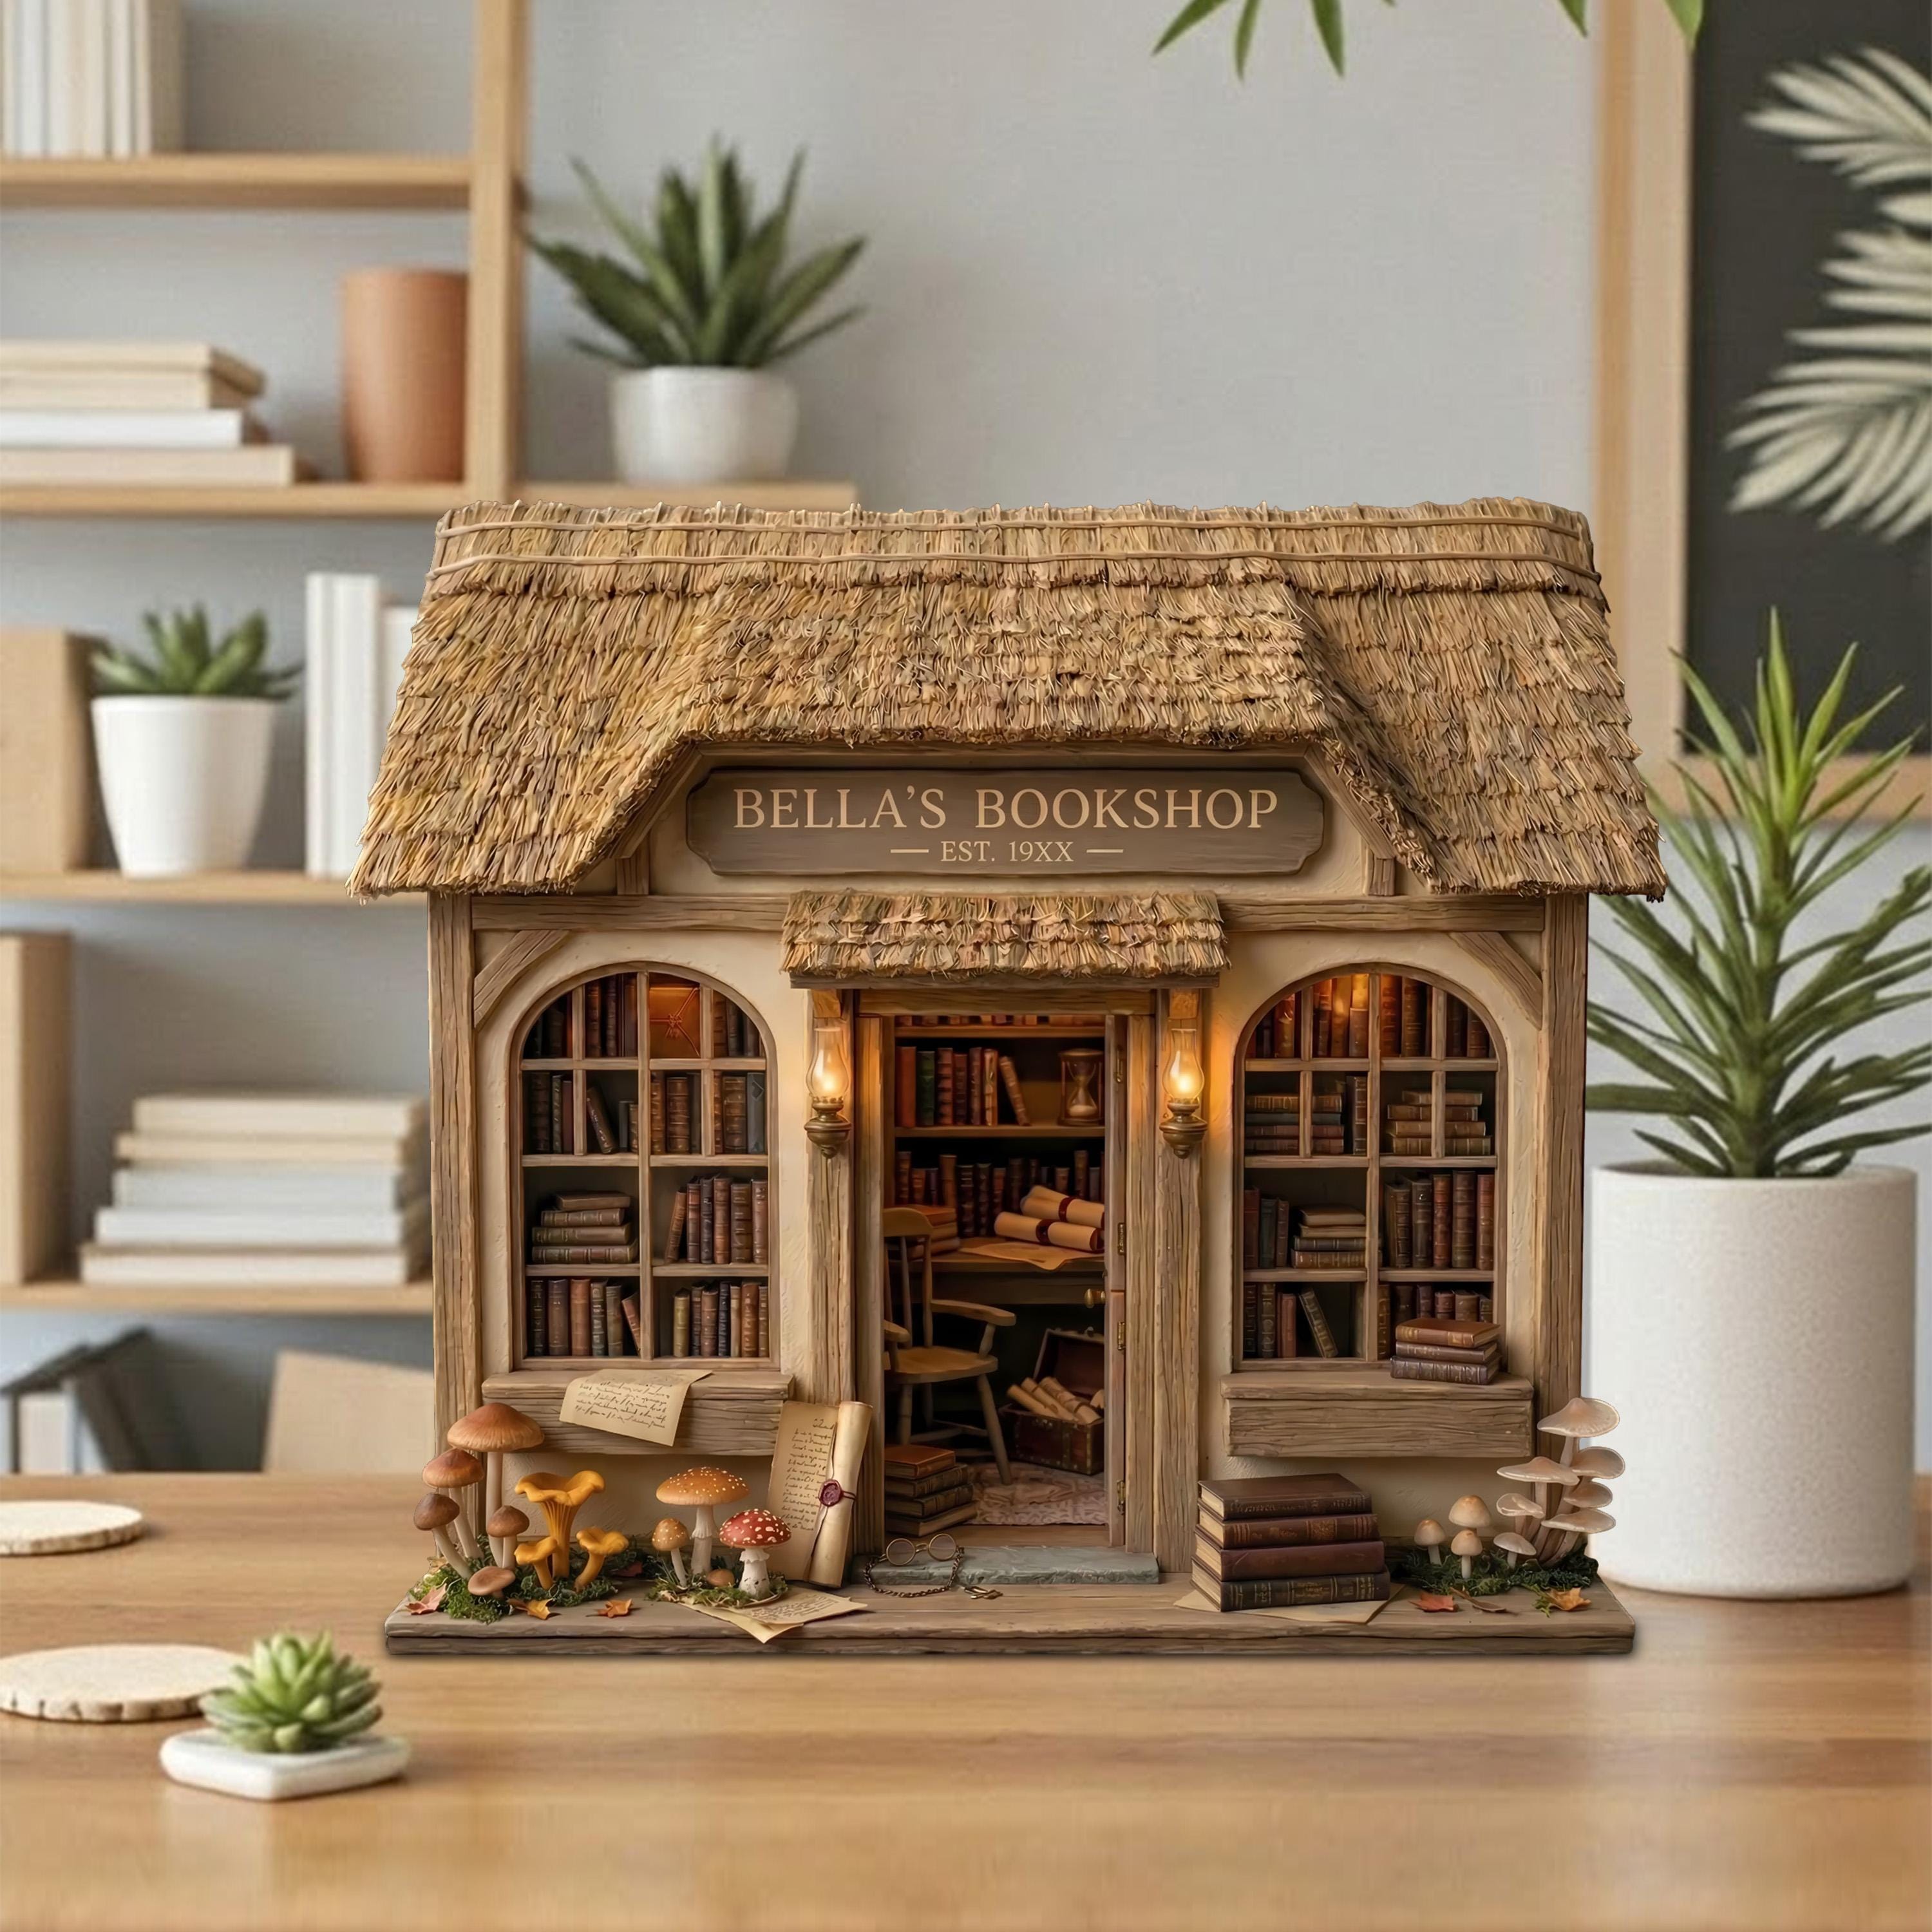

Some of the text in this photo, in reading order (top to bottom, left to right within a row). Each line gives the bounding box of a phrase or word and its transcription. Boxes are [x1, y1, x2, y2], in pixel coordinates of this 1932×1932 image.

[733, 785, 1278, 829] BELLA'S BOOKSHOP
[940, 840, 1075, 863] EST. 19XX
